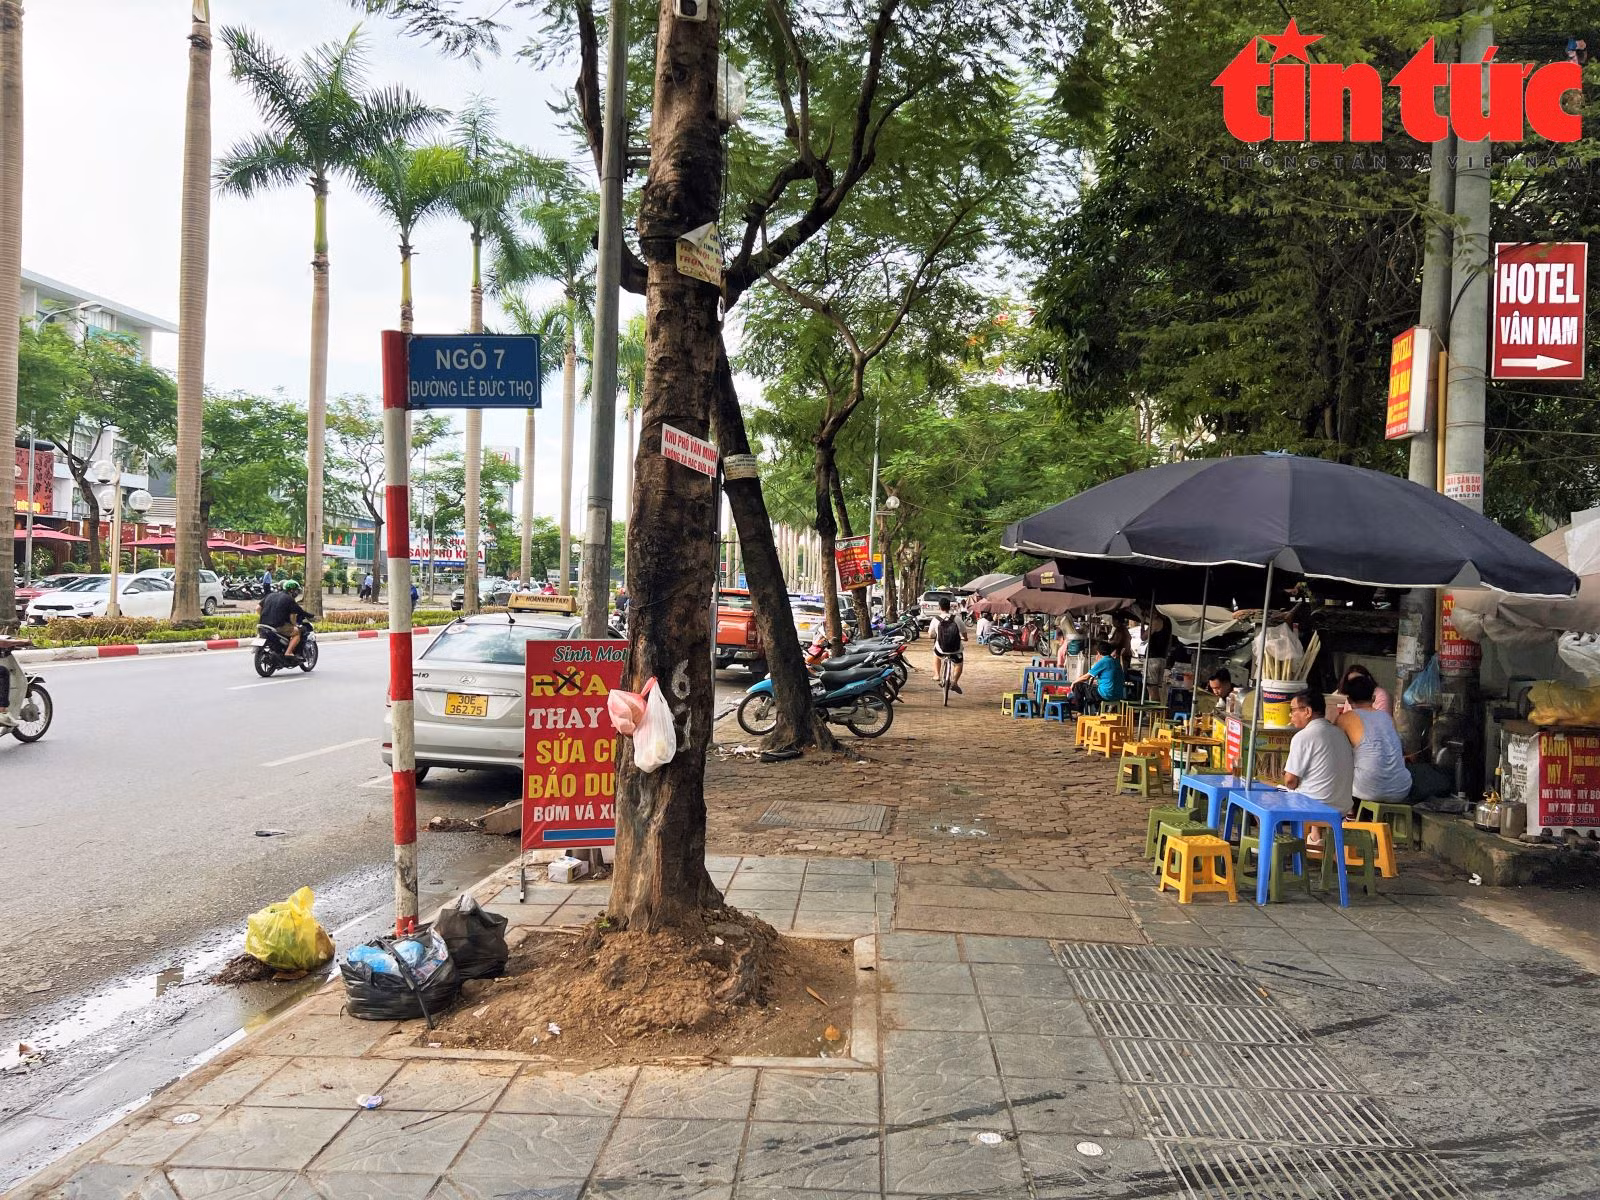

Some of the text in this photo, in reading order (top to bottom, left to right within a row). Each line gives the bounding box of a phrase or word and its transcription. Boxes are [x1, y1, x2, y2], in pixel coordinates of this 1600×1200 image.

[1500, 263, 1580, 304] HOTEL
[1500, 310, 1578, 345] VÂN NAM
[436, 342, 505, 370] NGÕ 7
[411, 376, 534, 401] ĐƯỜNG LÊ ĐỨC THỌ
[664, 428, 677, 445] KHU
[553, 646, 592, 662] Sinh
[531, 666, 609, 697] RỬA
[449, 705, 483, 716] 362.75
[458, 695, 477, 705] 30E
[529, 707, 604, 729] THAY
[536, 732, 586, 764] SỬA
[528, 767, 577, 798] BẢO
[1548, 760, 1562, 784] MỲ
[534, 805, 570, 822] BƠM
[575, 802, 595, 820] VÁ
